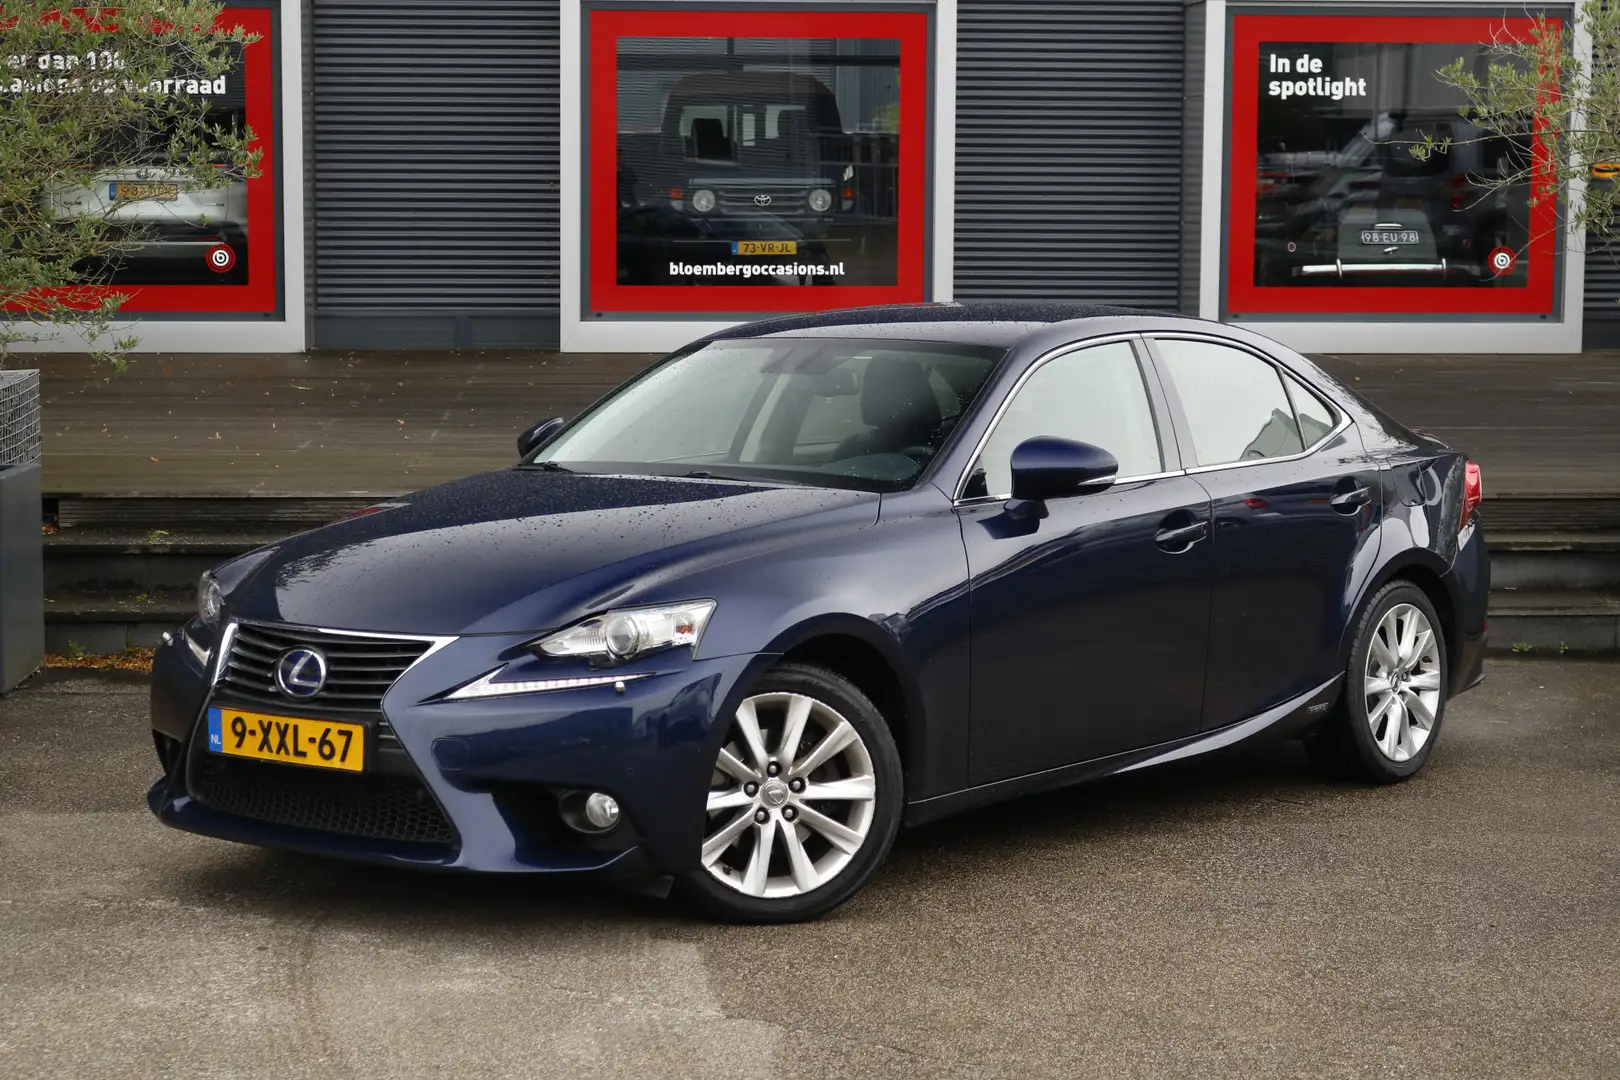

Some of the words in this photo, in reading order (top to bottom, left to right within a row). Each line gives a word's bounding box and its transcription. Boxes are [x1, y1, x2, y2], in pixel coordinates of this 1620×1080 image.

[1270, 53, 1291, 73] In
[1296, 53, 1323, 73] de
[1268, 76, 1367, 100] spotlight
[1364, 232, 1416, 242] 98-EU-98
[743, 243, 792, 253] 73-VR-JL
[669, 261, 845, 278] bloembergoccasions.nl
[210, 733, 222, 745] NL
[231, 716, 354, 762] 9-XXL-67
